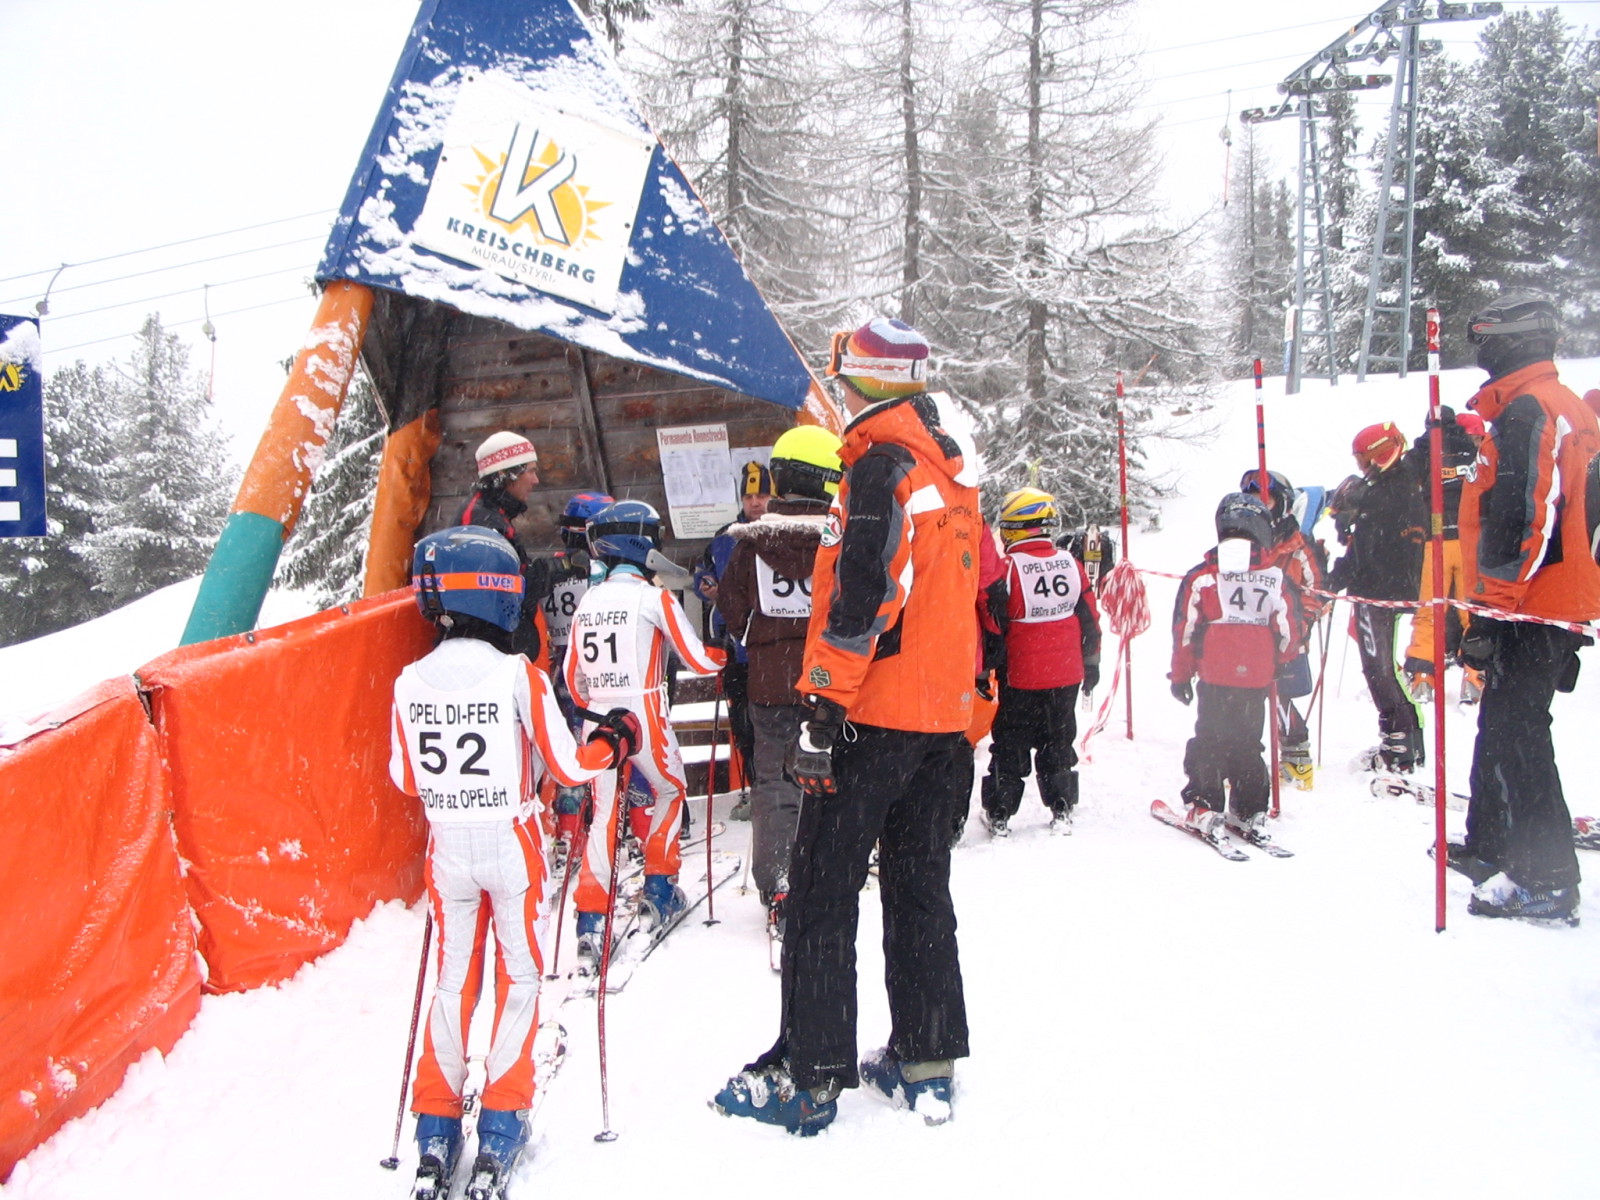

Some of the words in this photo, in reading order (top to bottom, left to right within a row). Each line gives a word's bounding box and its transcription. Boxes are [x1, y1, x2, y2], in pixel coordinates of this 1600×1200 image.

[447, 216, 596, 284] KREISCHBERG
[471, 246, 557, 284] MURAU/STYRI
[1022, 562, 1046, 575] OPEL
[1045, 560, 1072, 572] DI-FER
[1033, 574, 1070, 598] 46
[1248, 572, 1277, 589] DI-FER
[545, 591, 578, 618] 48
[1229, 586, 1270, 612] 47
[595, 610, 628, 626] DI-FER
[583, 631, 618, 664] 51
[593, 677, 600, 688] az
[599, 671, 631, 688] OPELért
[409, 702, 442, 725] OPEL
[446, 702, 499, 725] DI-FER
[419, 731, 491, 777] 52
[446, 794, 459, 809] az
[459, 786, 509, 809] OPELért
